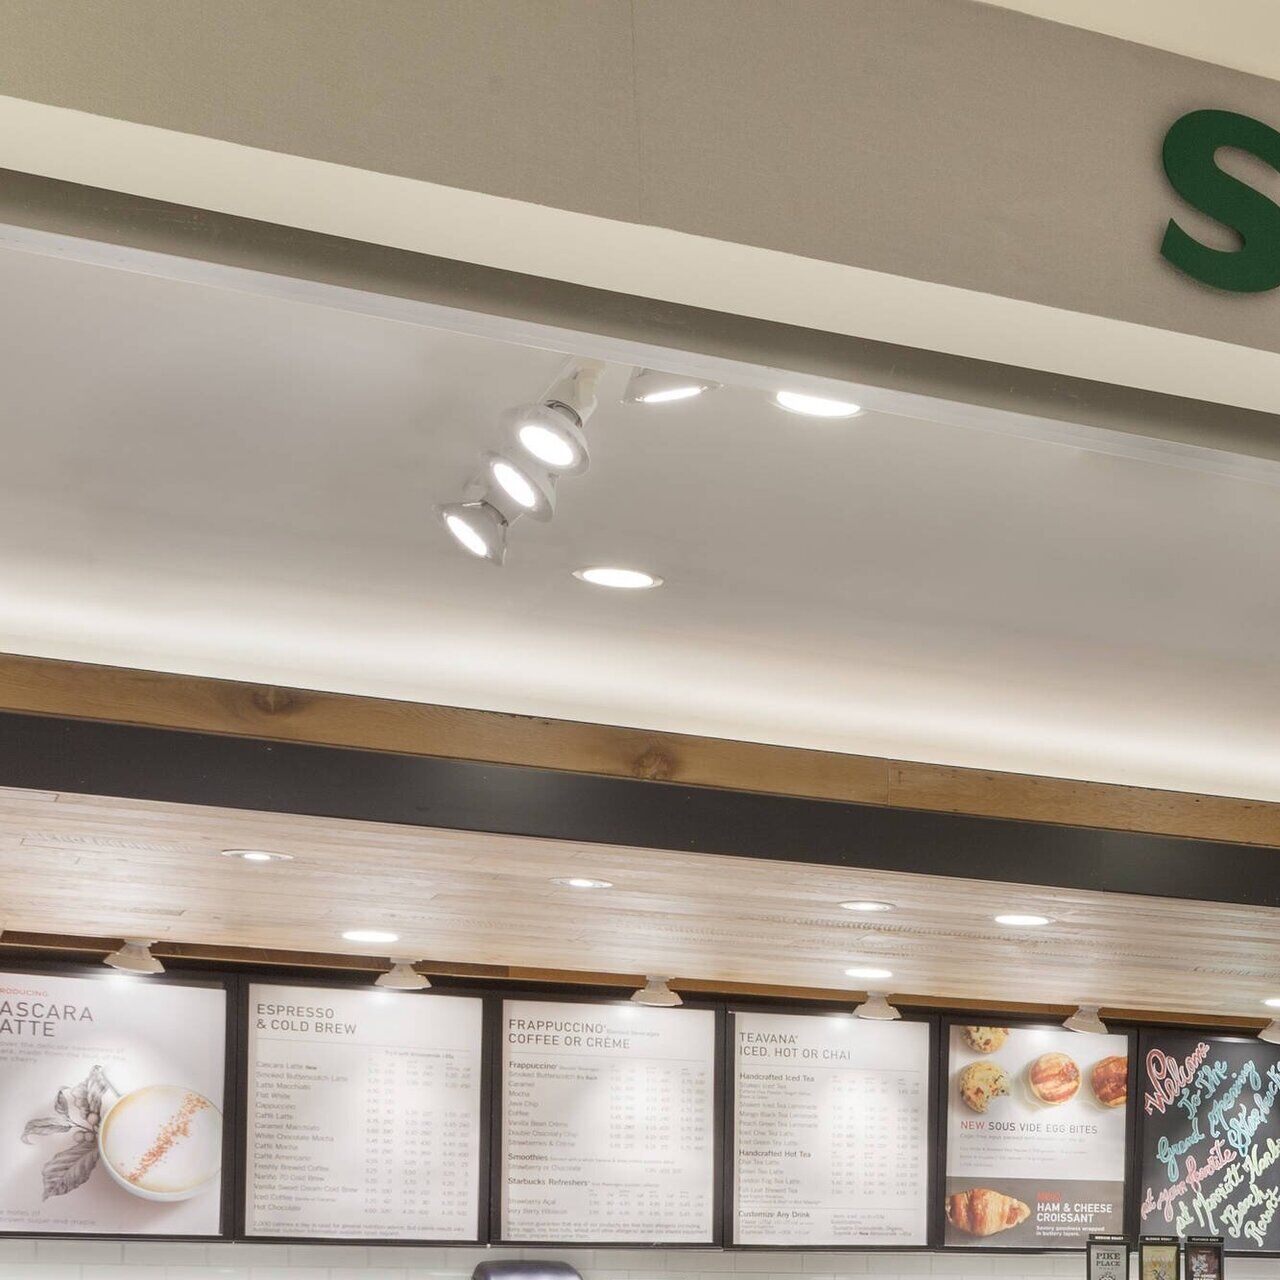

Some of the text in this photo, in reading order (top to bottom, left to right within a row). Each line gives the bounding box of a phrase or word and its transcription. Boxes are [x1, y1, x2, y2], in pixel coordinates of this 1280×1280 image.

[0, 1001, 93, 1021] ASCARA
[256, 1004, 334, 1020] ESPRESSO
[0, 1020, 55, 1037] ATTE
[256, 1018, 356, 1035] & COLD BREW
[509, 1033, 559, 1046] COFFEE
[565, 1036, 581, 1046] OR
[774, 1048, 797, 1058] HOT
[803, 1049, 818, 1059] OR
[822, 1049, 850, 1060] CHAI
[785, 1074, 800, 1082] Iced
[960, 1121, 1097, 1134] NEW SOUS VIDE EGG BITES
[508, 1153, 548, 1161] Smoothies
[508, 1177, 545, 1185] Starbucks
[1037, 1203, 1112, 1213] HAM & CHEESE
[777, 1211, 790, 1219] Any
[1037, 1213, 1094, 1223] CROISSANT
